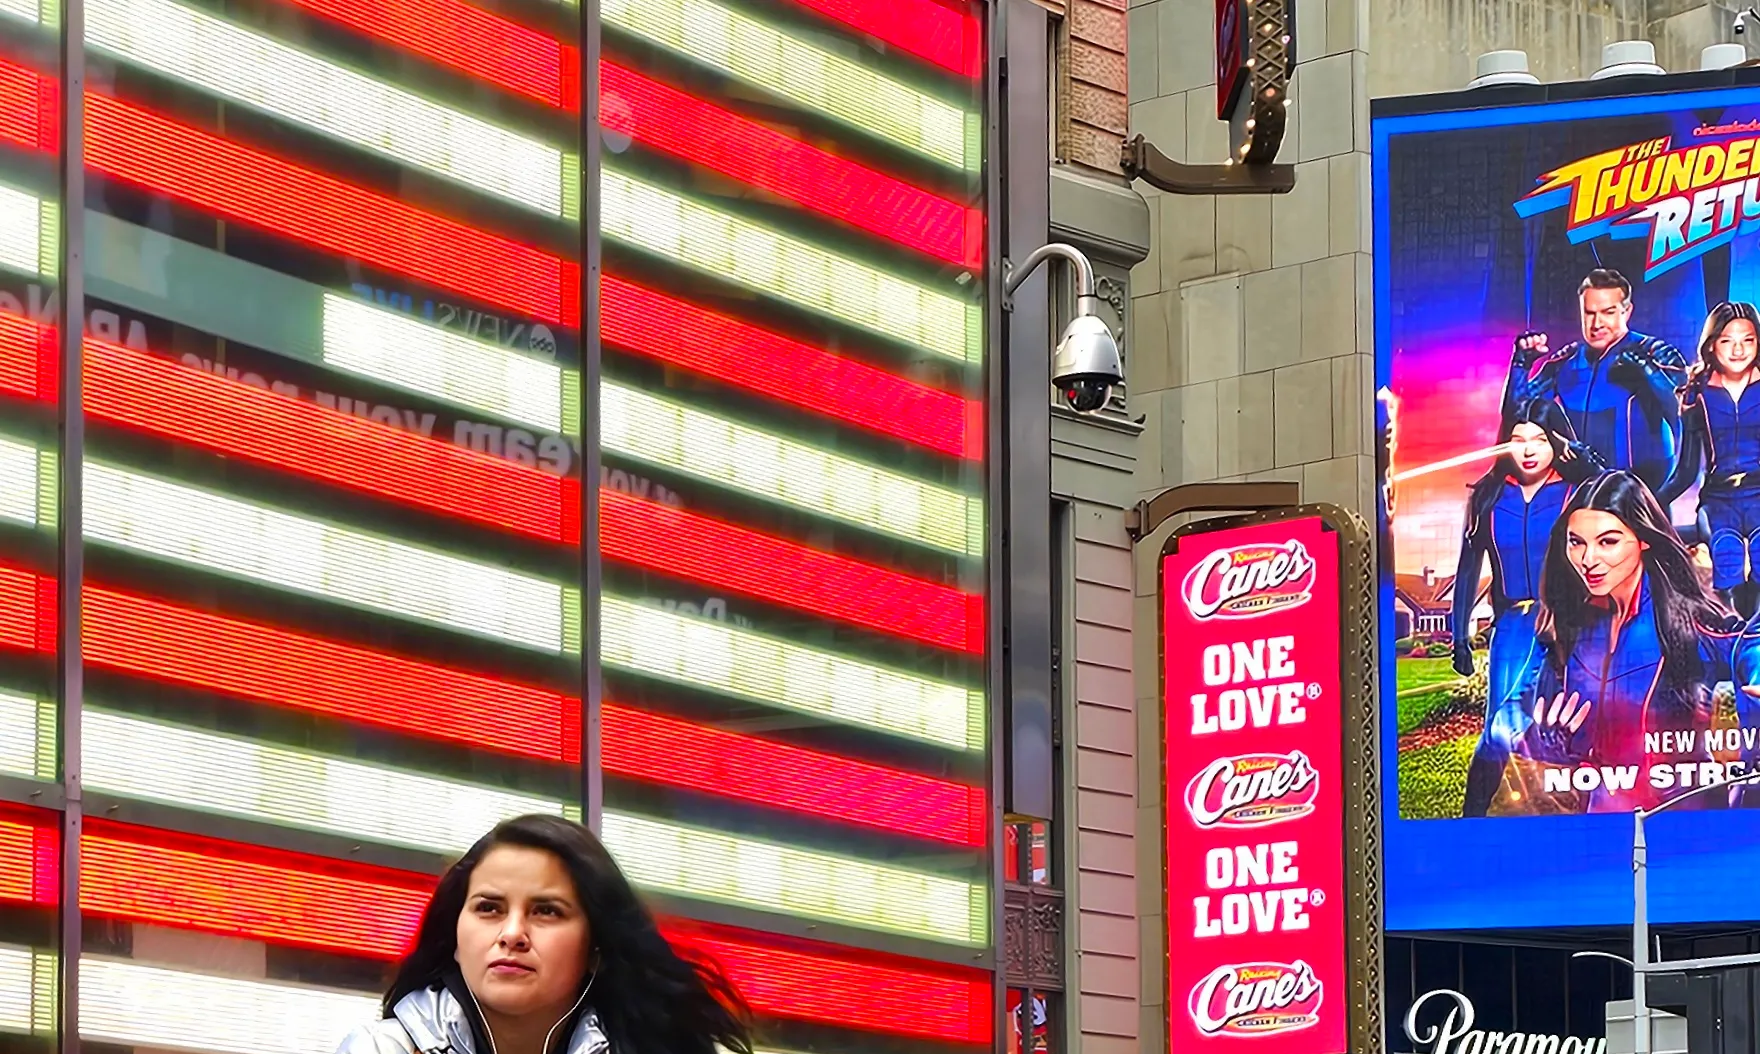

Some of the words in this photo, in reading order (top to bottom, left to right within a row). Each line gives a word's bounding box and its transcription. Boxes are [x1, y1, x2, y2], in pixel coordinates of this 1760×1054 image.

[1626, 138, 1665, 163] THE
[1522, 138, 1760, 225] THUNDE
[1628, 177, 1760, 262] RETU
[1189, 541, 1310, 617] Cane's
[1203, 635, 1295, 686] ONE
[1645, 730, 1696, 754] NEW
[1704, 727, 1760, 753] MOV
[1193, 751, 1313, 825] Cane's
[1544, 766, 1638, 792] NOW
[1205, 841, 1299, 889] ONE
[1197, 961, 1319, 1033] Cane's
